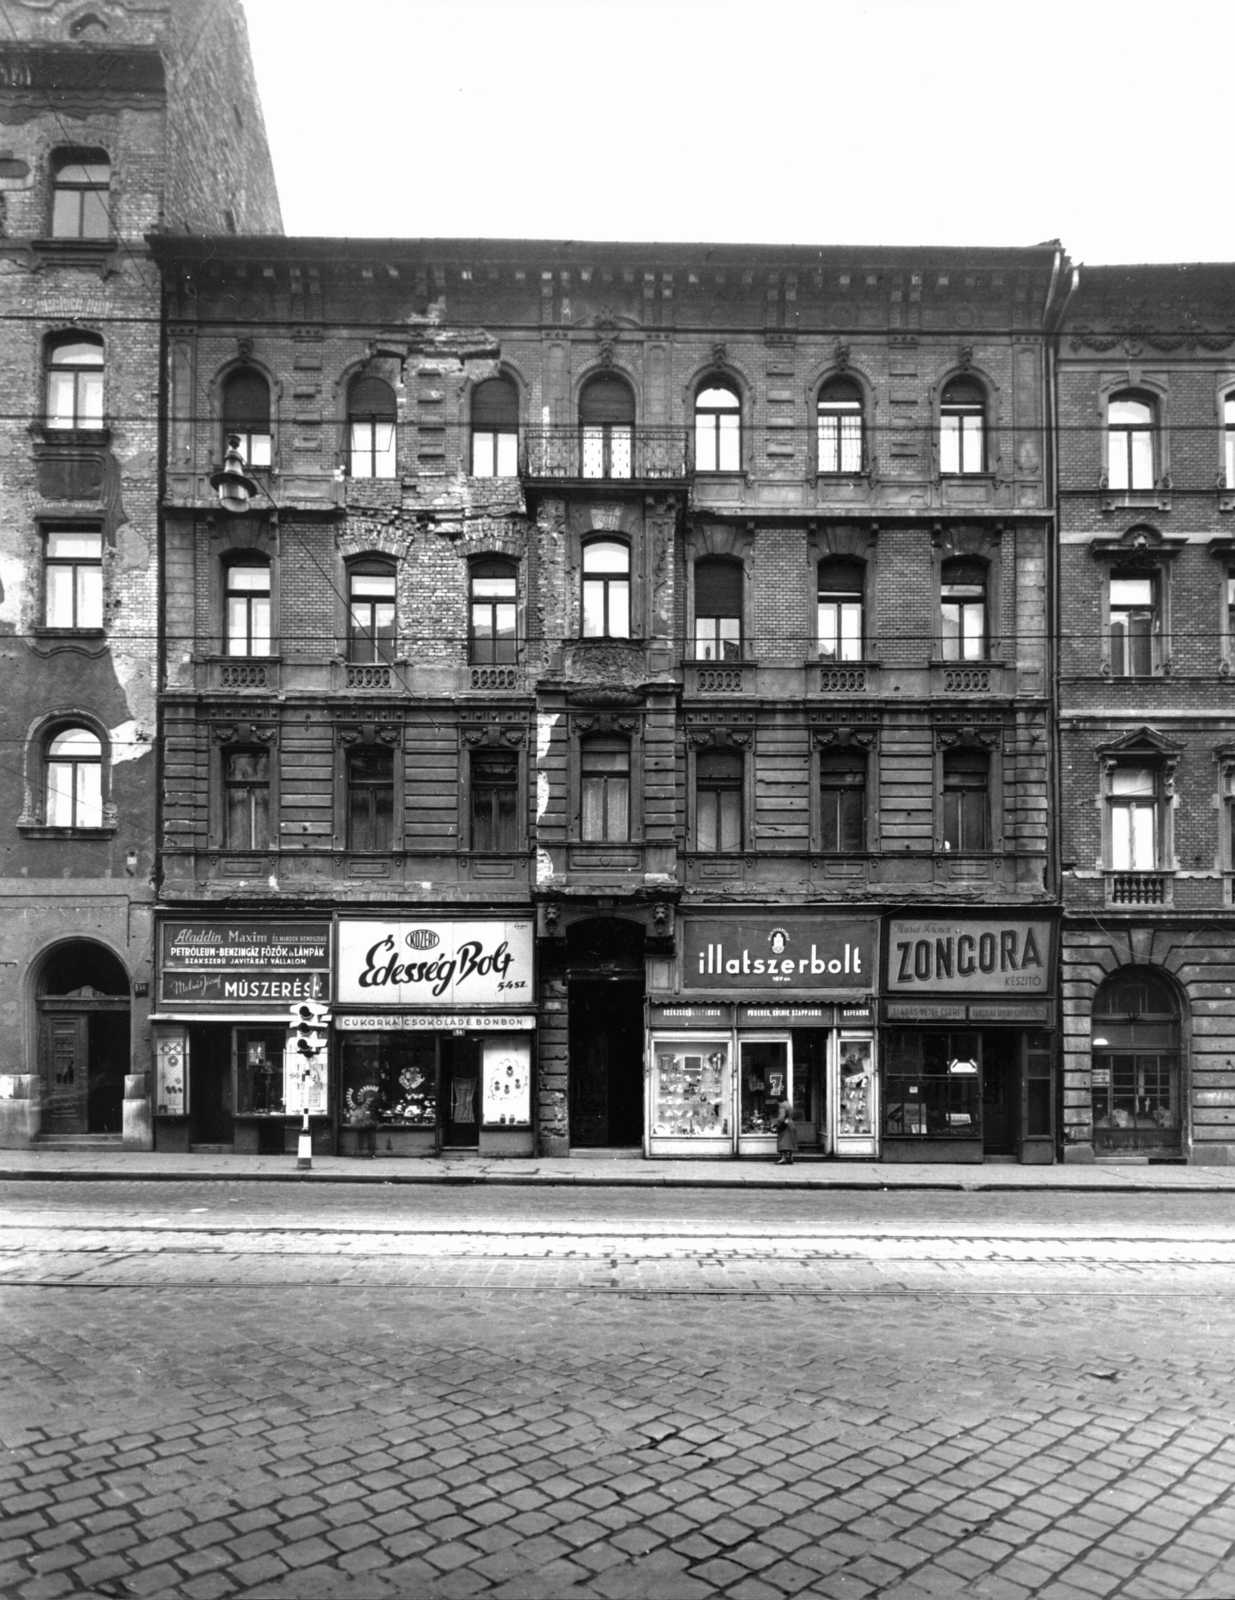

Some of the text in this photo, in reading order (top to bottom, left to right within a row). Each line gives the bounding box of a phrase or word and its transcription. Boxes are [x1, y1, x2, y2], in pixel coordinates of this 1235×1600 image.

[228, 930, 267, 943] Maxim
[294, 945, 325, 957] LÁMPÁK
[699, 943, 862, 974] illatszerbolt
[896, 927, 1044, 984] ZONGORA
[270, 956, 307, 965] VÁLLALOM
[358, 934, 515, 997] Édesség Bolt
[225, 978, 322, 998] MŰSZERÉS
[344, 1018, 399, 1027] CUKORKA
[475, 1018, 523, 1026] BONBON
